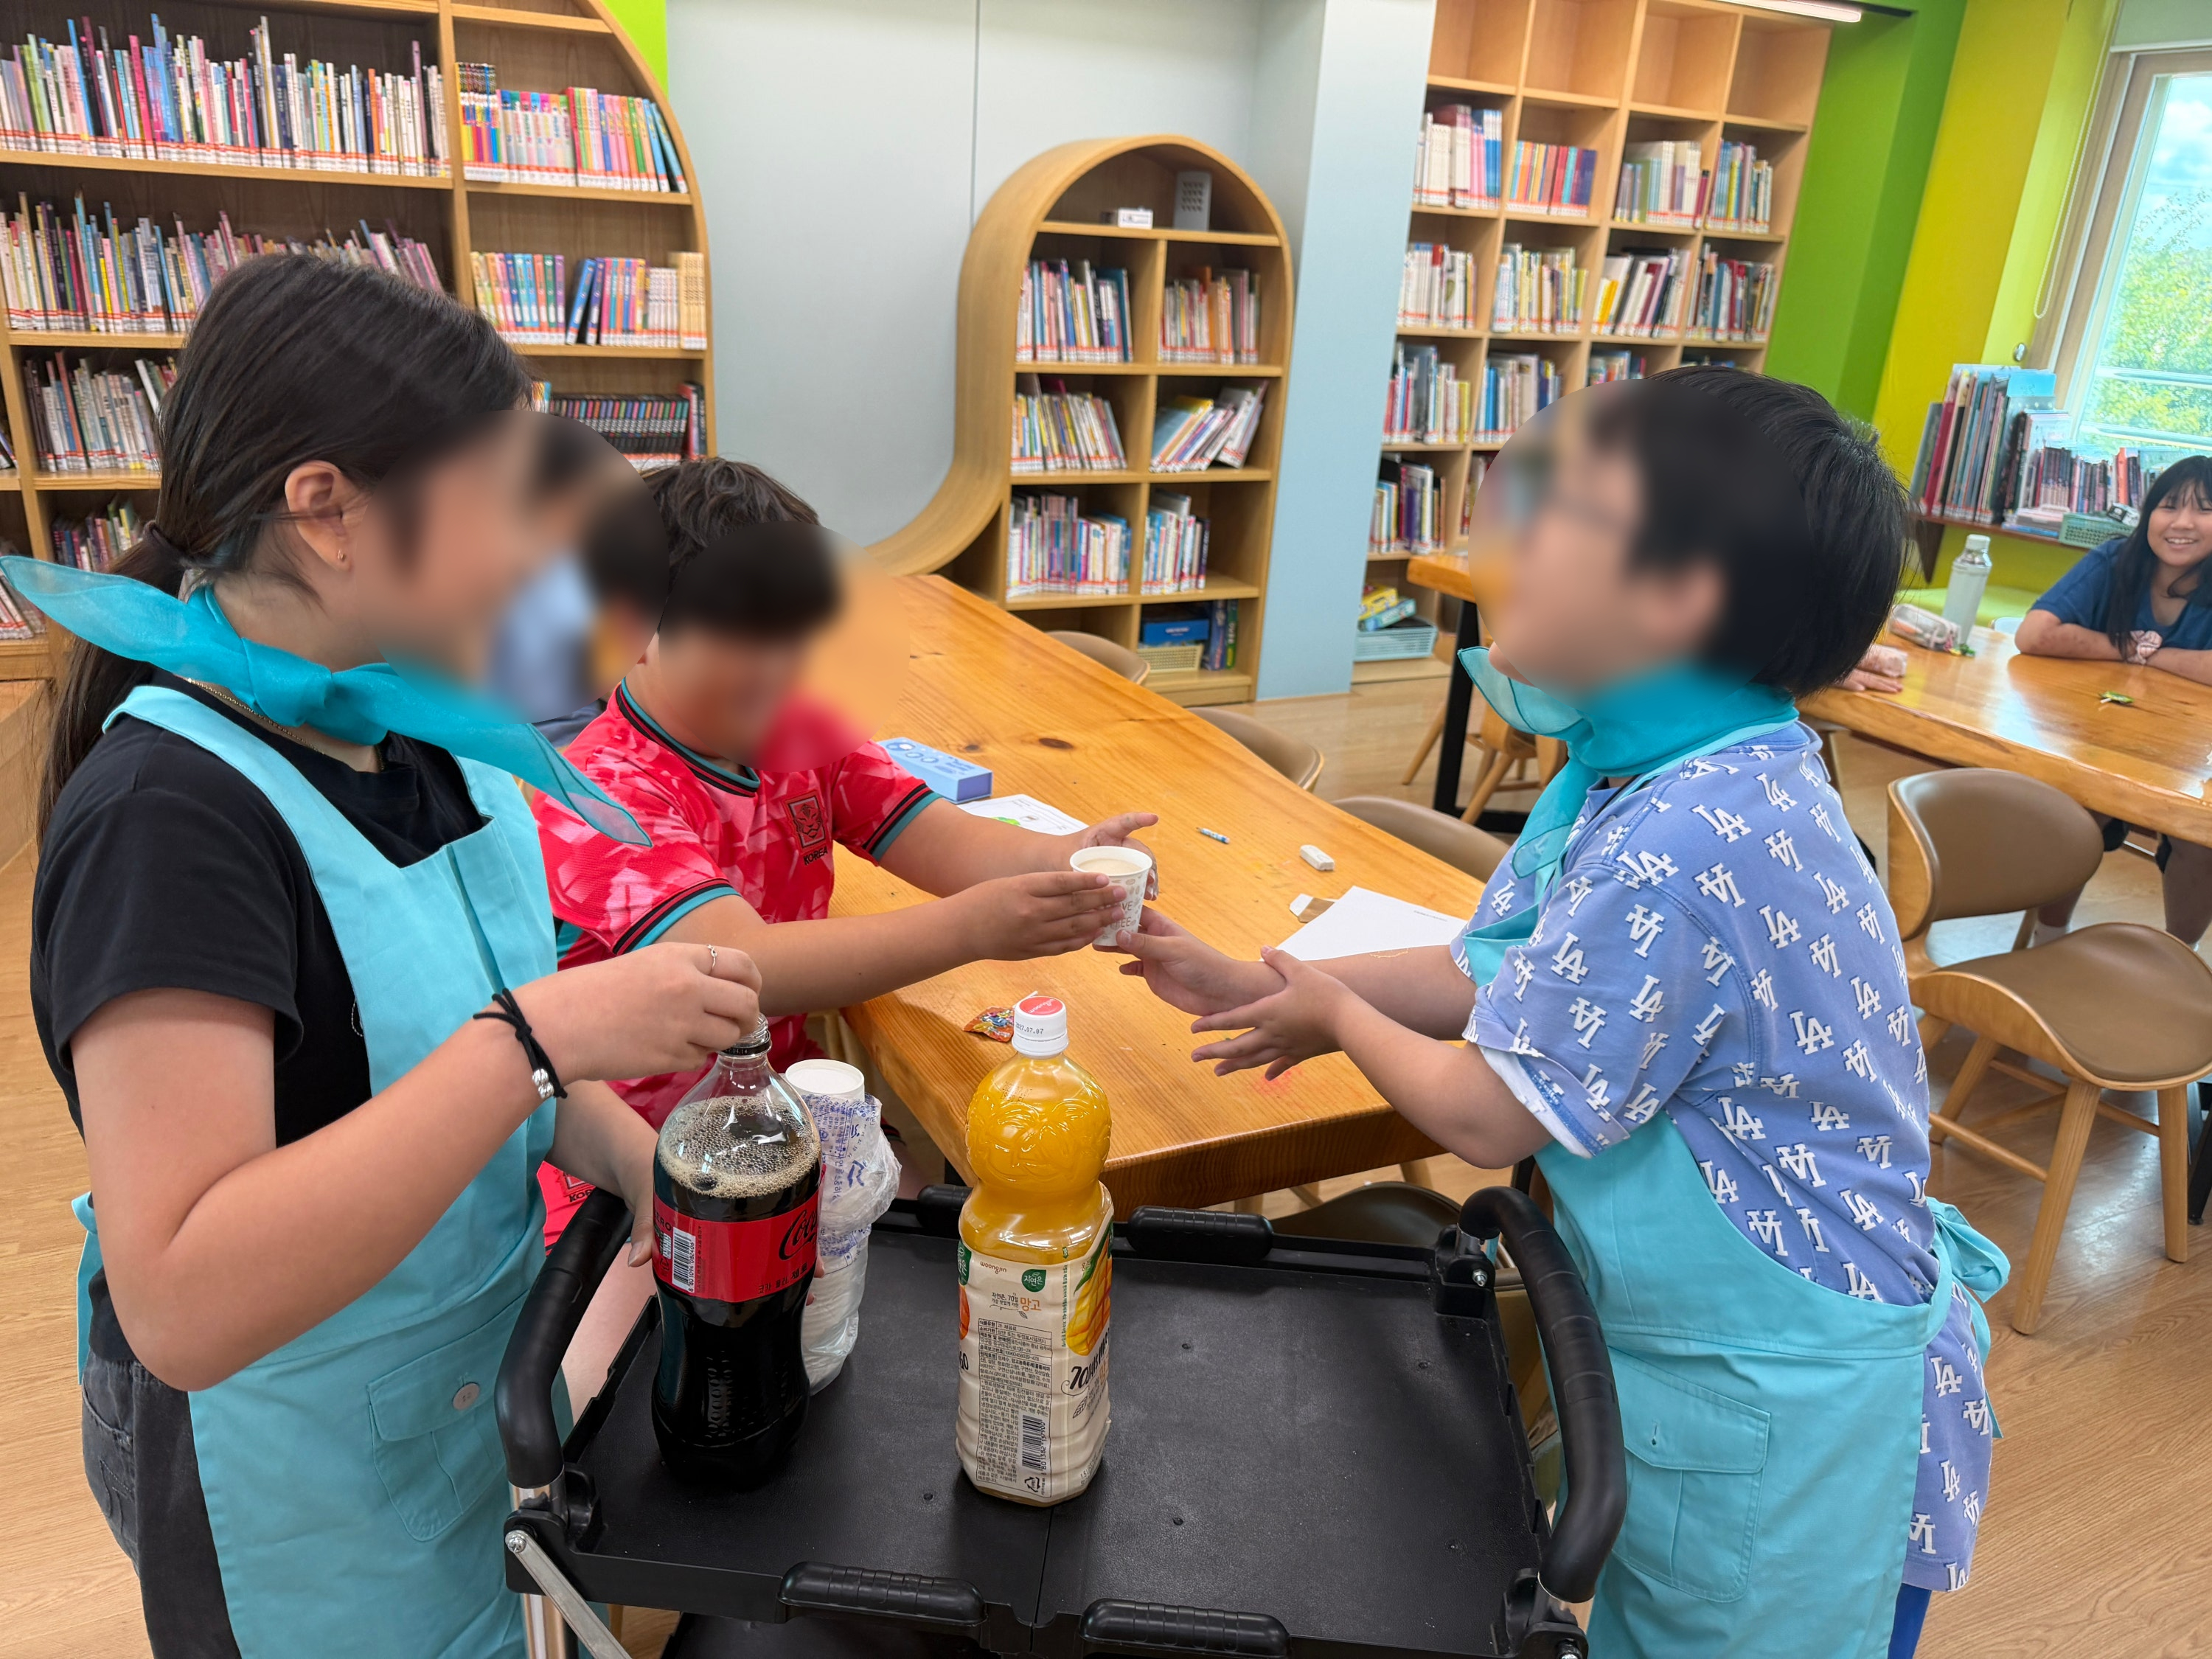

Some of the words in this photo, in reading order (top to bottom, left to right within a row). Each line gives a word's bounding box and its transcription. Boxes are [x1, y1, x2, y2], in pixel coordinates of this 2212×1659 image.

[1756, 772, 1798, 813] LA
[1691, 804, 1752, 843] LA
[1810, 802, 1842, 843] LA
[804, 846, 828, 866] KOREA
[1617, 848, 1679, 888] LA
[1763, 828, 1804, 872] LA
[1491, 878, 1515, 917] LA
[1564, 874, 1593, 917] LA
[1694, 861, 1747, 908] LA
[1814, 872, 1850, 914] LA
[1625, 902, 1664, 958] LA
[1759, 904, 1801, 949] LA
[1856, 901, 1885, 945] LA
[1513, 951, 1535, 1001] LA
[1551, 931, 1588, 984] LA
[1700, 936, 1735, 987] LA
[1809, 933, 1842, 978] LA
[1629, 974, 1664, 1023] LA
[1750, 967, 1779, 1012] LA
[1850, 975, 1882, 1020] LA
[1568, 997, 1607, 1049] LA
[1789, 1010, 1835, 1056] LA
[1886, 1004, 1912, 1048] LA
[1843, 1038, 1877, 1083] LA
[1624, 1082, 1659, 1124] LA
[1717, 1096, 1767, 1141] LA
[1808, 1100, 1850, 1132] LA
[1775, 1142, 1827, 1189] LA
[1855, 1134, 1893, 1171] LA
[1698, 1160, 1740, 1204] LA
[1839, 1189, 1884, 1231] LA
[1746, 1209, 1789, 1257] LA
[791, 1262, 808, 1280] 제로
[980, 1261, 1007, 1275] woongjin
[1023, 1275, 1043, 1287] 자연은
[1008, 1295, 1019, 1304] 70일
[1020, 1295, 1042, 1312] 망고
[1930, 1356, 1963, 1399] LA
[1940, 1459, 1961, 1503] LA
